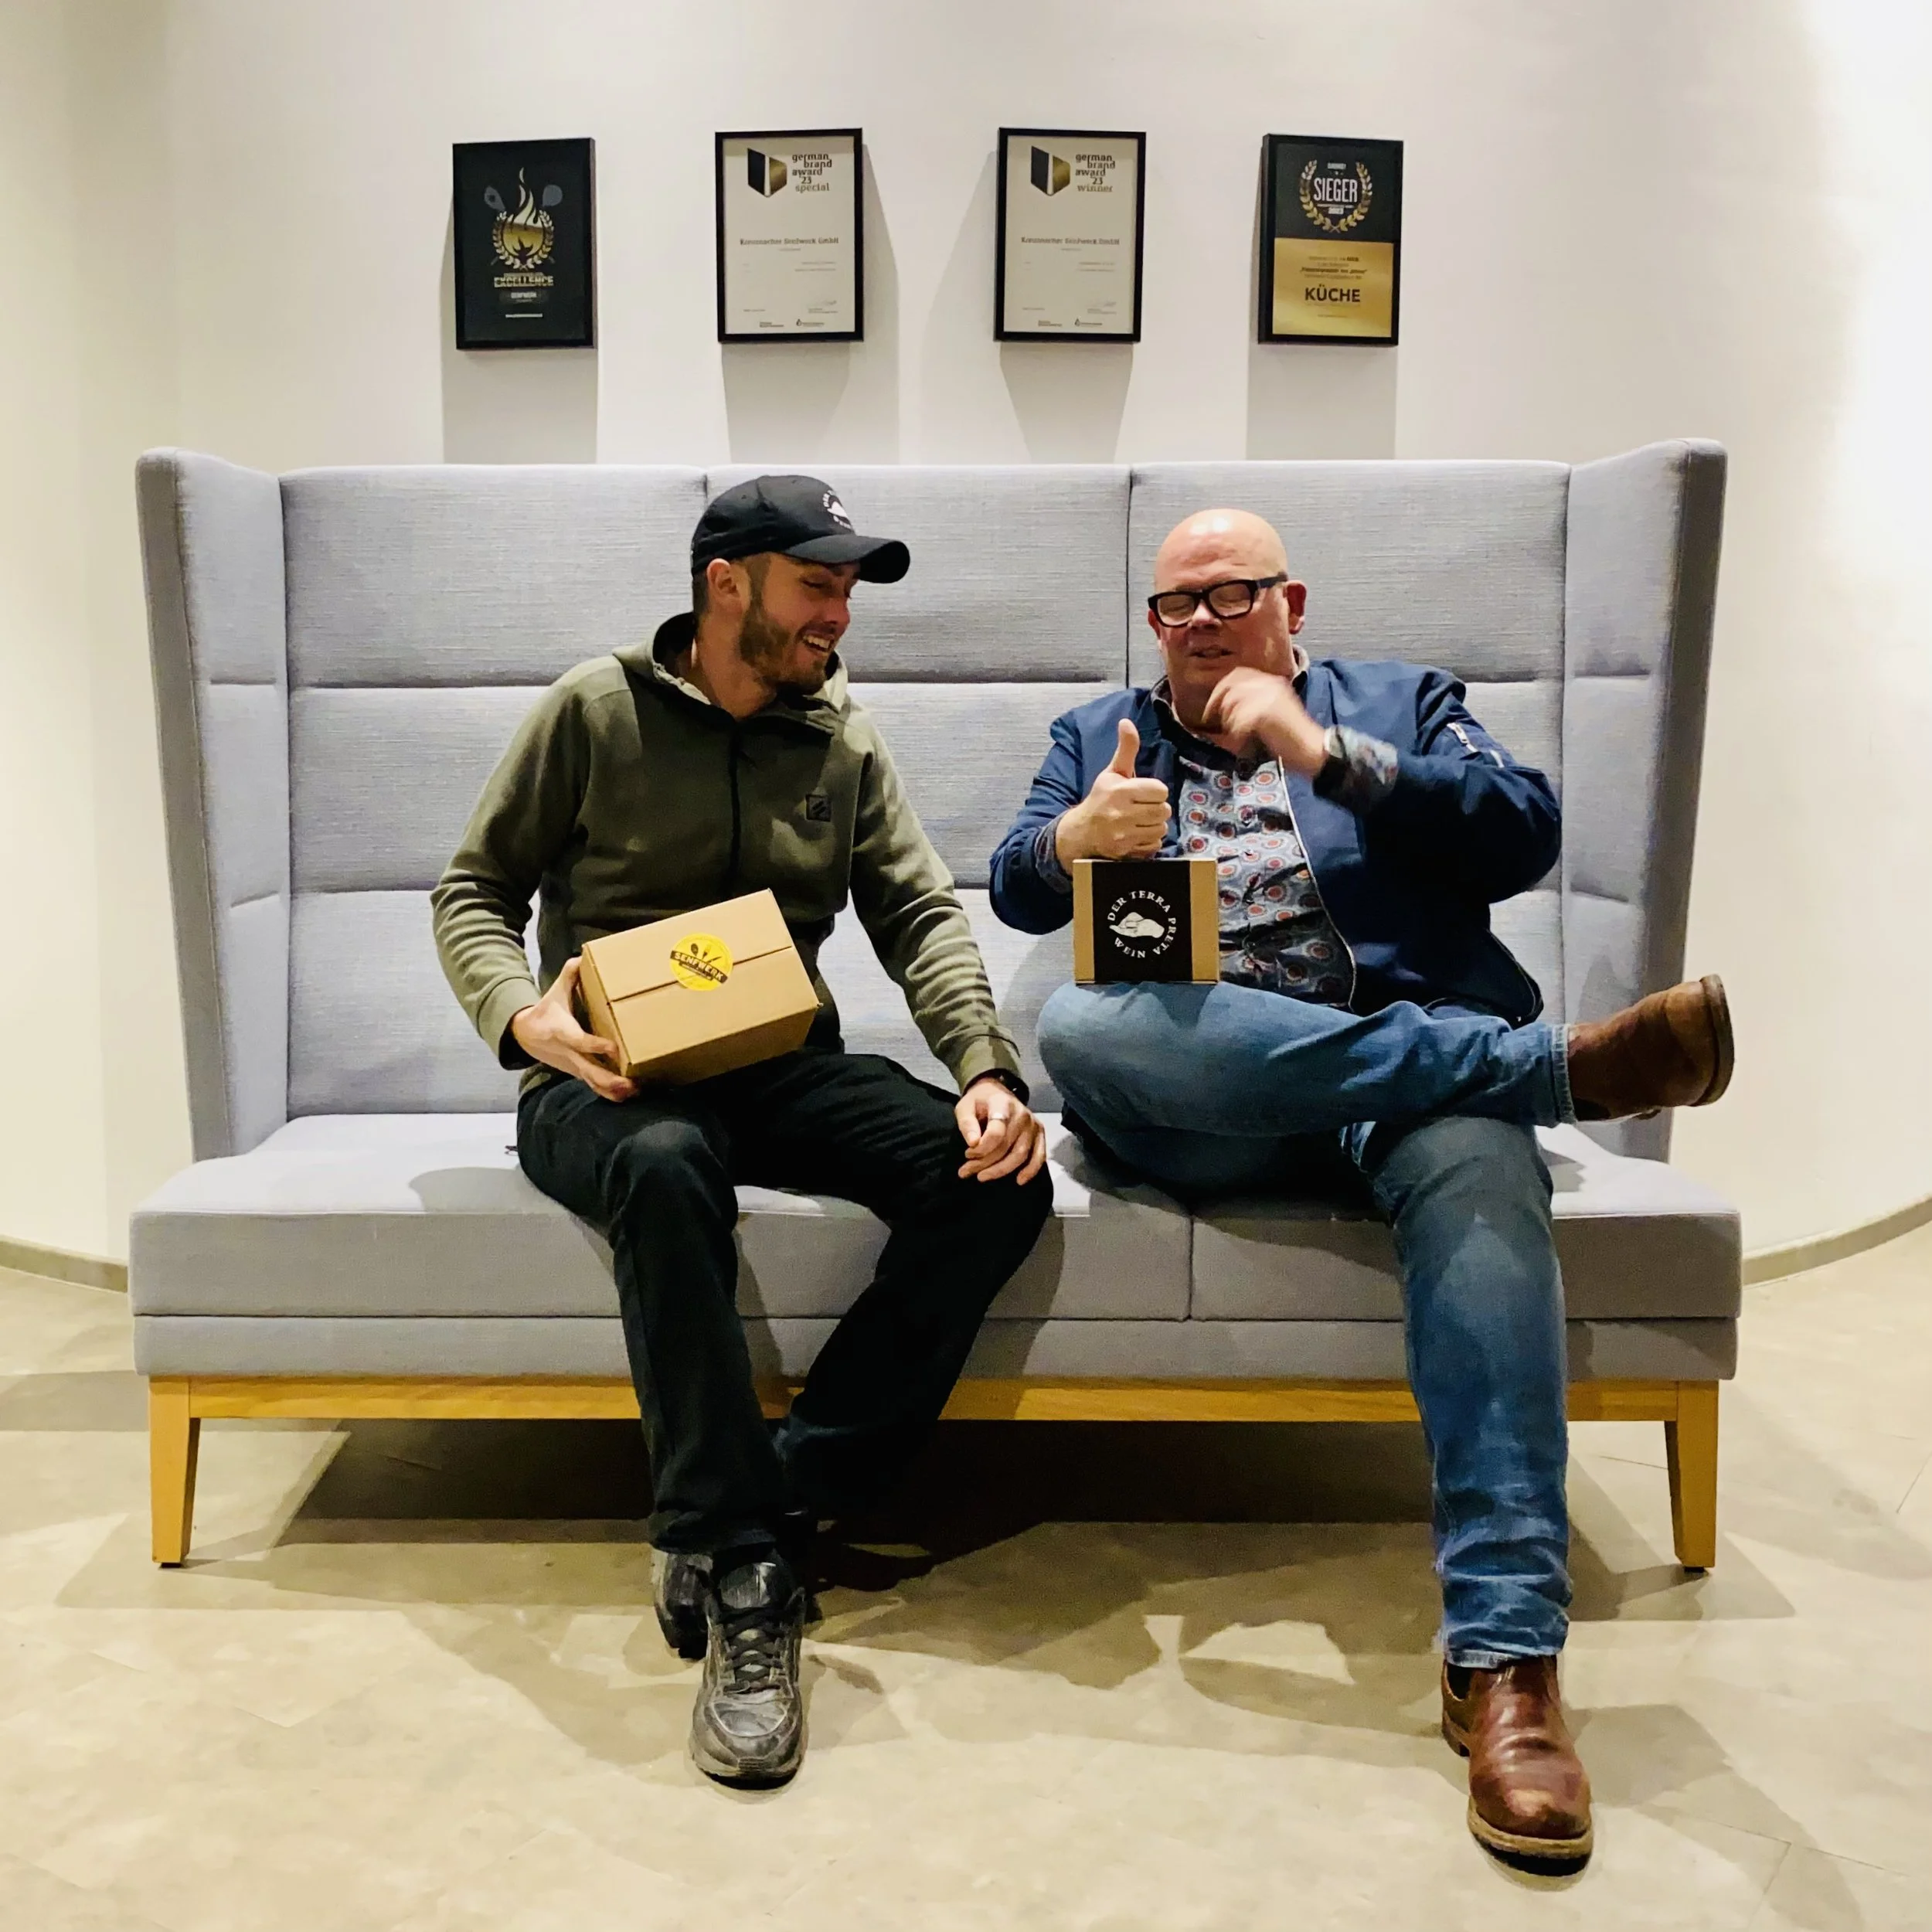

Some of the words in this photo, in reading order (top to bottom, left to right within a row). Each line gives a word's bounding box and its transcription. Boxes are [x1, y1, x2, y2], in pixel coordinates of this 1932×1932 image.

[792, 154, 829, 163] german
[804, 159, 832, 168] brand
[1076, 154, 1113, 163] german
[1087, 161, 1115, 169] brand
[795, 182, 829, 193] special
[1314, 177, 1358, 202] SIEGER
[494, 275, 554, 287] EXCELLENCE
[1304, 283, 1360, 302] KÜCHE
[1107, 896, 1127, 921] DER
[1129, 890, 1171, 913] TERRA
[1152, 917, 1177, 955] PRETA
[1114, 937, 1146, 958] WEIN
[674, 951, 724, 981] SENFWERK
